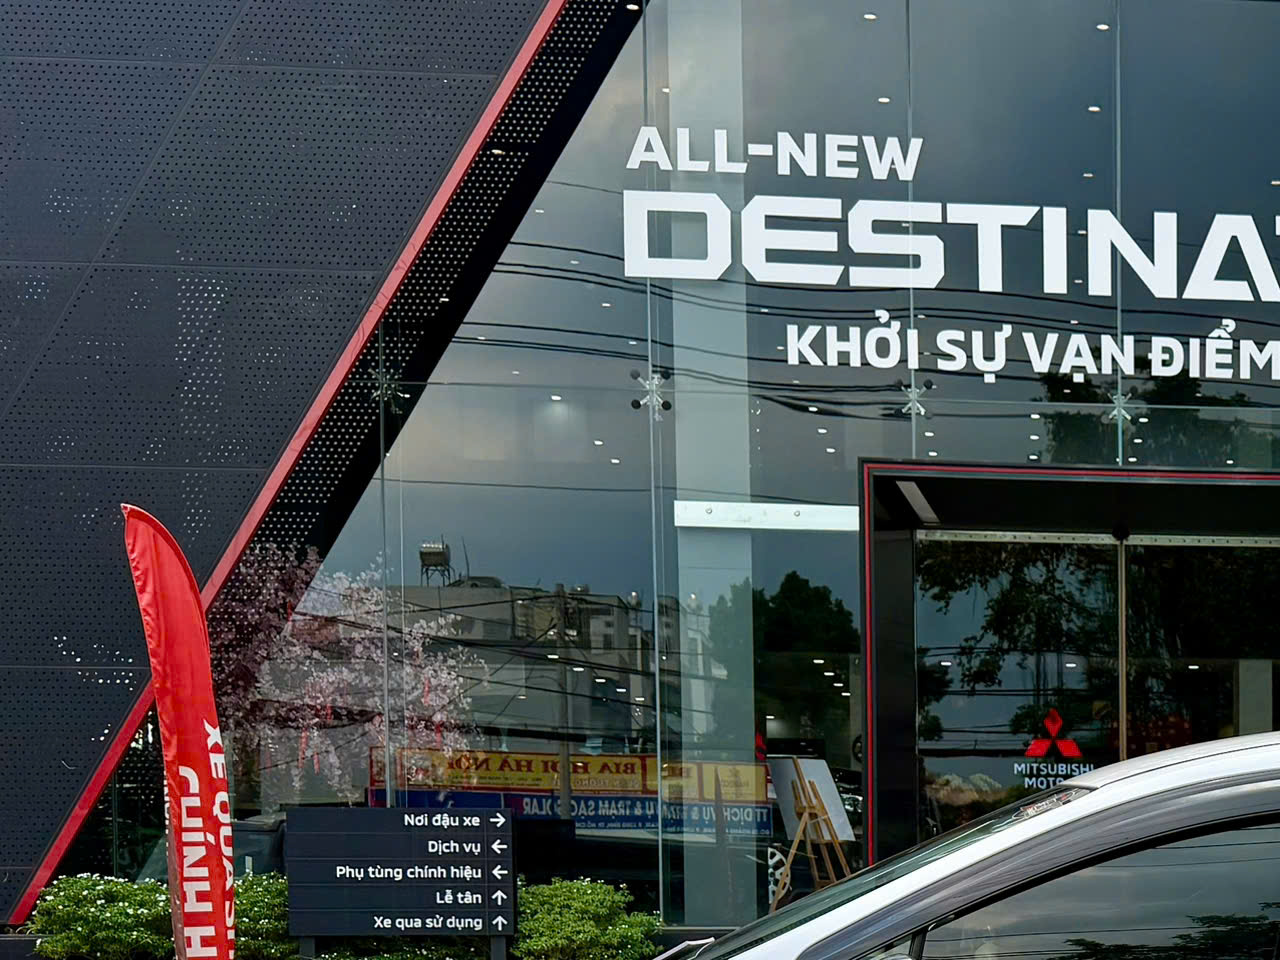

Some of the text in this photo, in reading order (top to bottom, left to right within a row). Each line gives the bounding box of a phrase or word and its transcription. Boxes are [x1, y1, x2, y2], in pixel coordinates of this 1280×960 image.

[625, 125, 925, 182] ALL-NEW
[786, 310, 920, 370] KHỞI
[936, 322, 1011, 385] SỰ
[1023, 330, 1136, 385] VẠN
[404, 813, 481, 829] Nơi đậu xe
[428, 840, 481, 855] Dịch vụ
[336, 865, 482, 881] Phụ tùng chính hiệu
[436, 889, 482, 904] Lễ tân
[373, 914, 483, 931] Xe qua sử dụng
